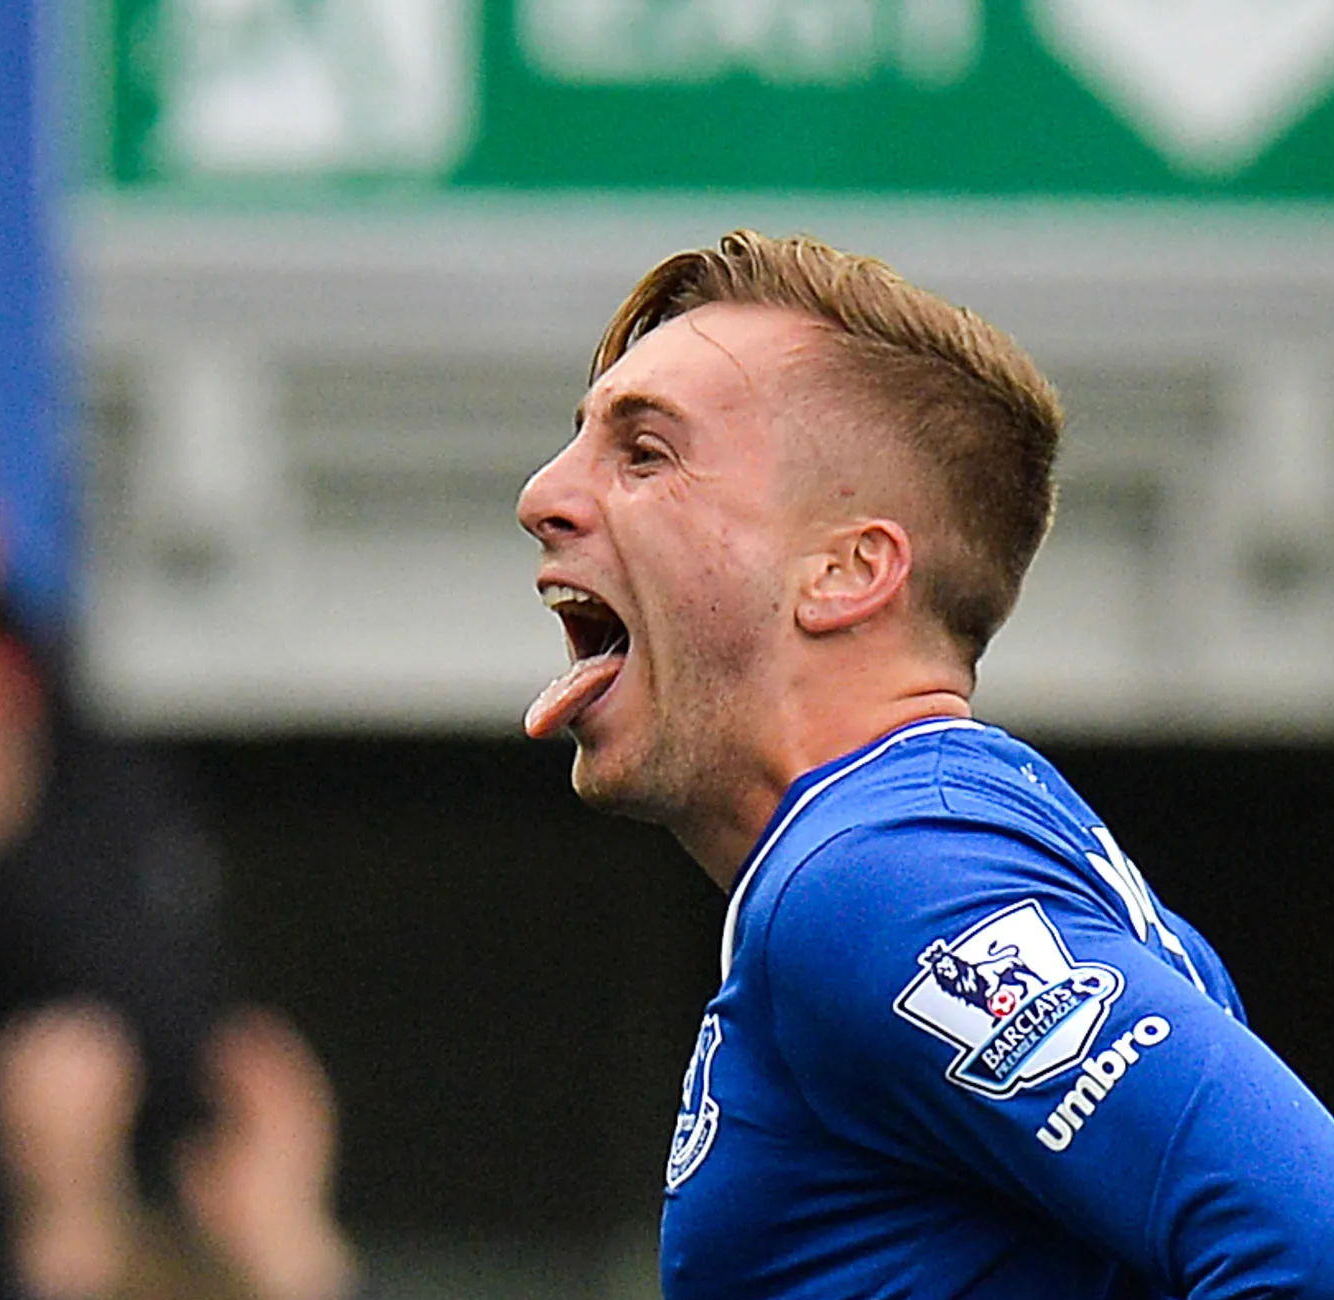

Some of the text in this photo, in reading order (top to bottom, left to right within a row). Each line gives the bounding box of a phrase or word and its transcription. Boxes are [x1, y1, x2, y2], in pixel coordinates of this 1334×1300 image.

[982, 986, 1071, 1070] BARCLAYS
[995, 996, 1082, 1079] PREMIER LEAGUE
[1036, 1016, 1171, 1152] umbro
